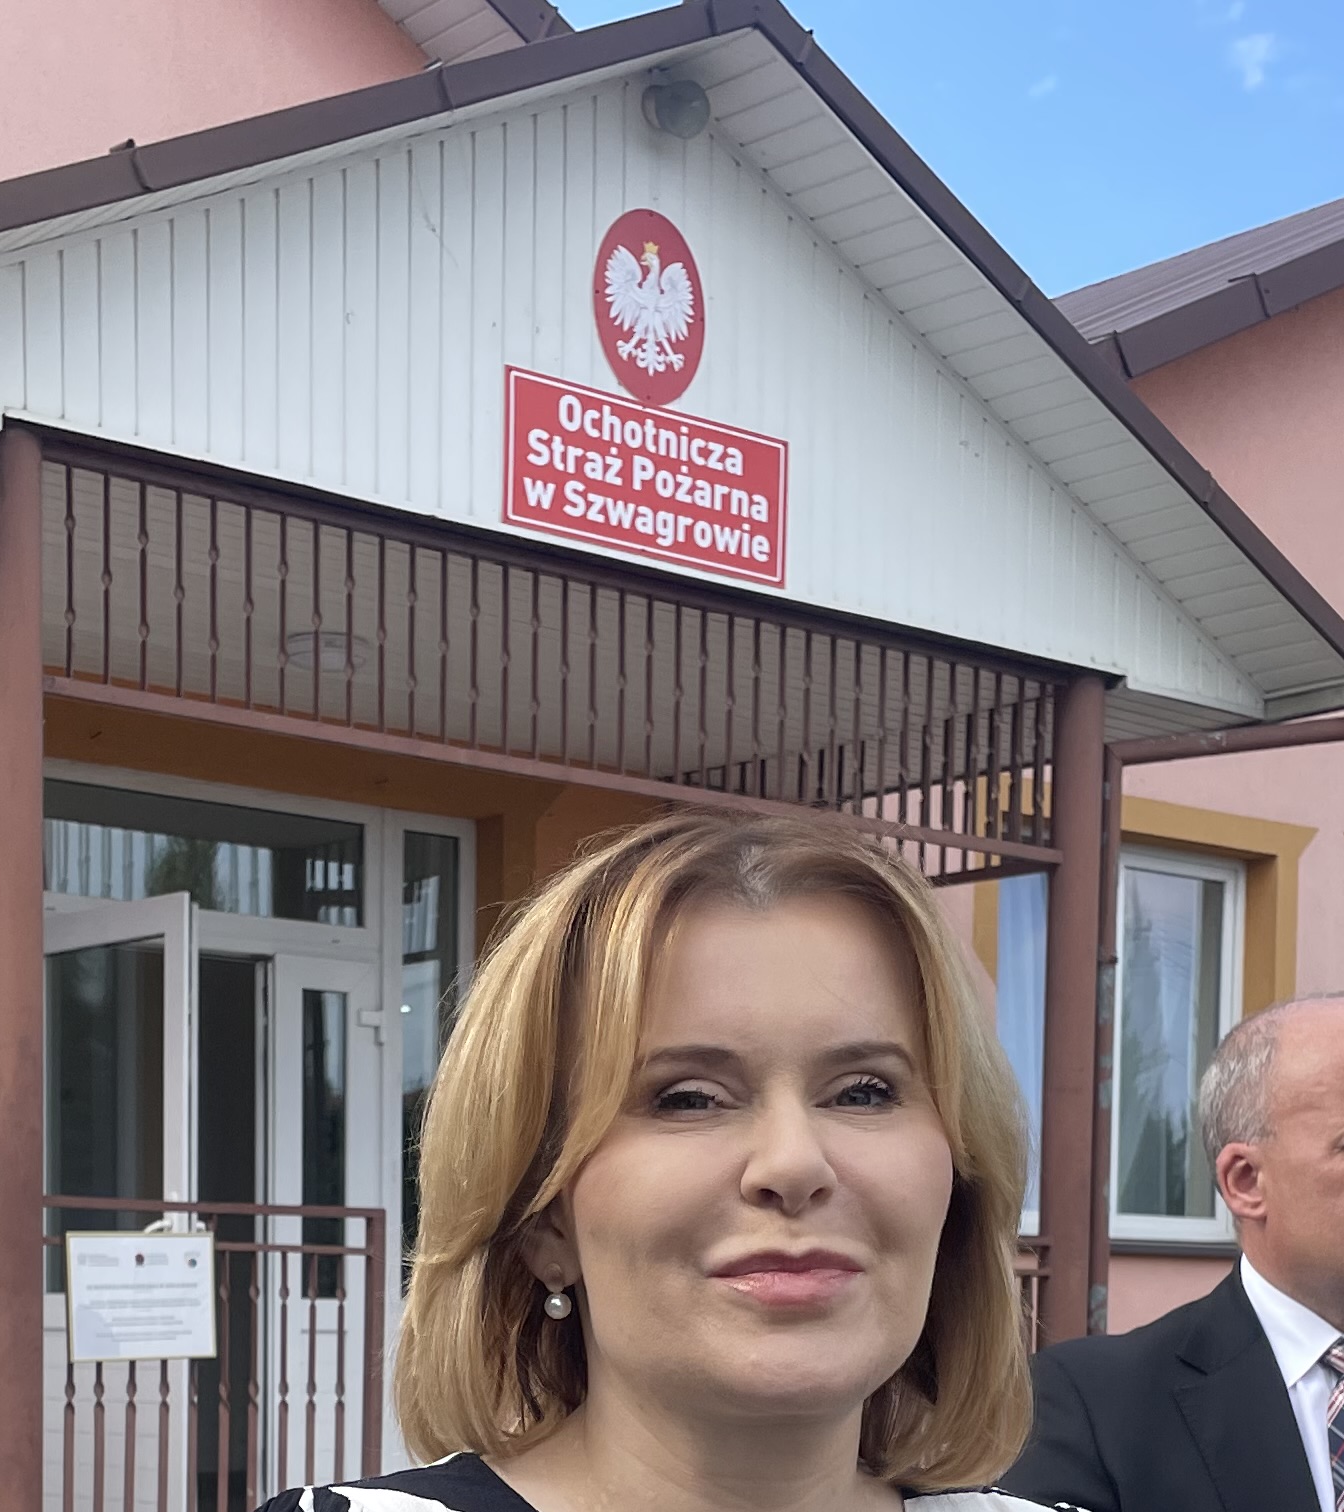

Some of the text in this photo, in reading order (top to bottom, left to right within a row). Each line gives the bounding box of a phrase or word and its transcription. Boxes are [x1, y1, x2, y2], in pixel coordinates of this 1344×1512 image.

[526, 428, 769, 523] Straż Pożarna
[558, 394, 744, 476] Ochotnicza
[523, 476, 770, 562] w Szwagrowie
